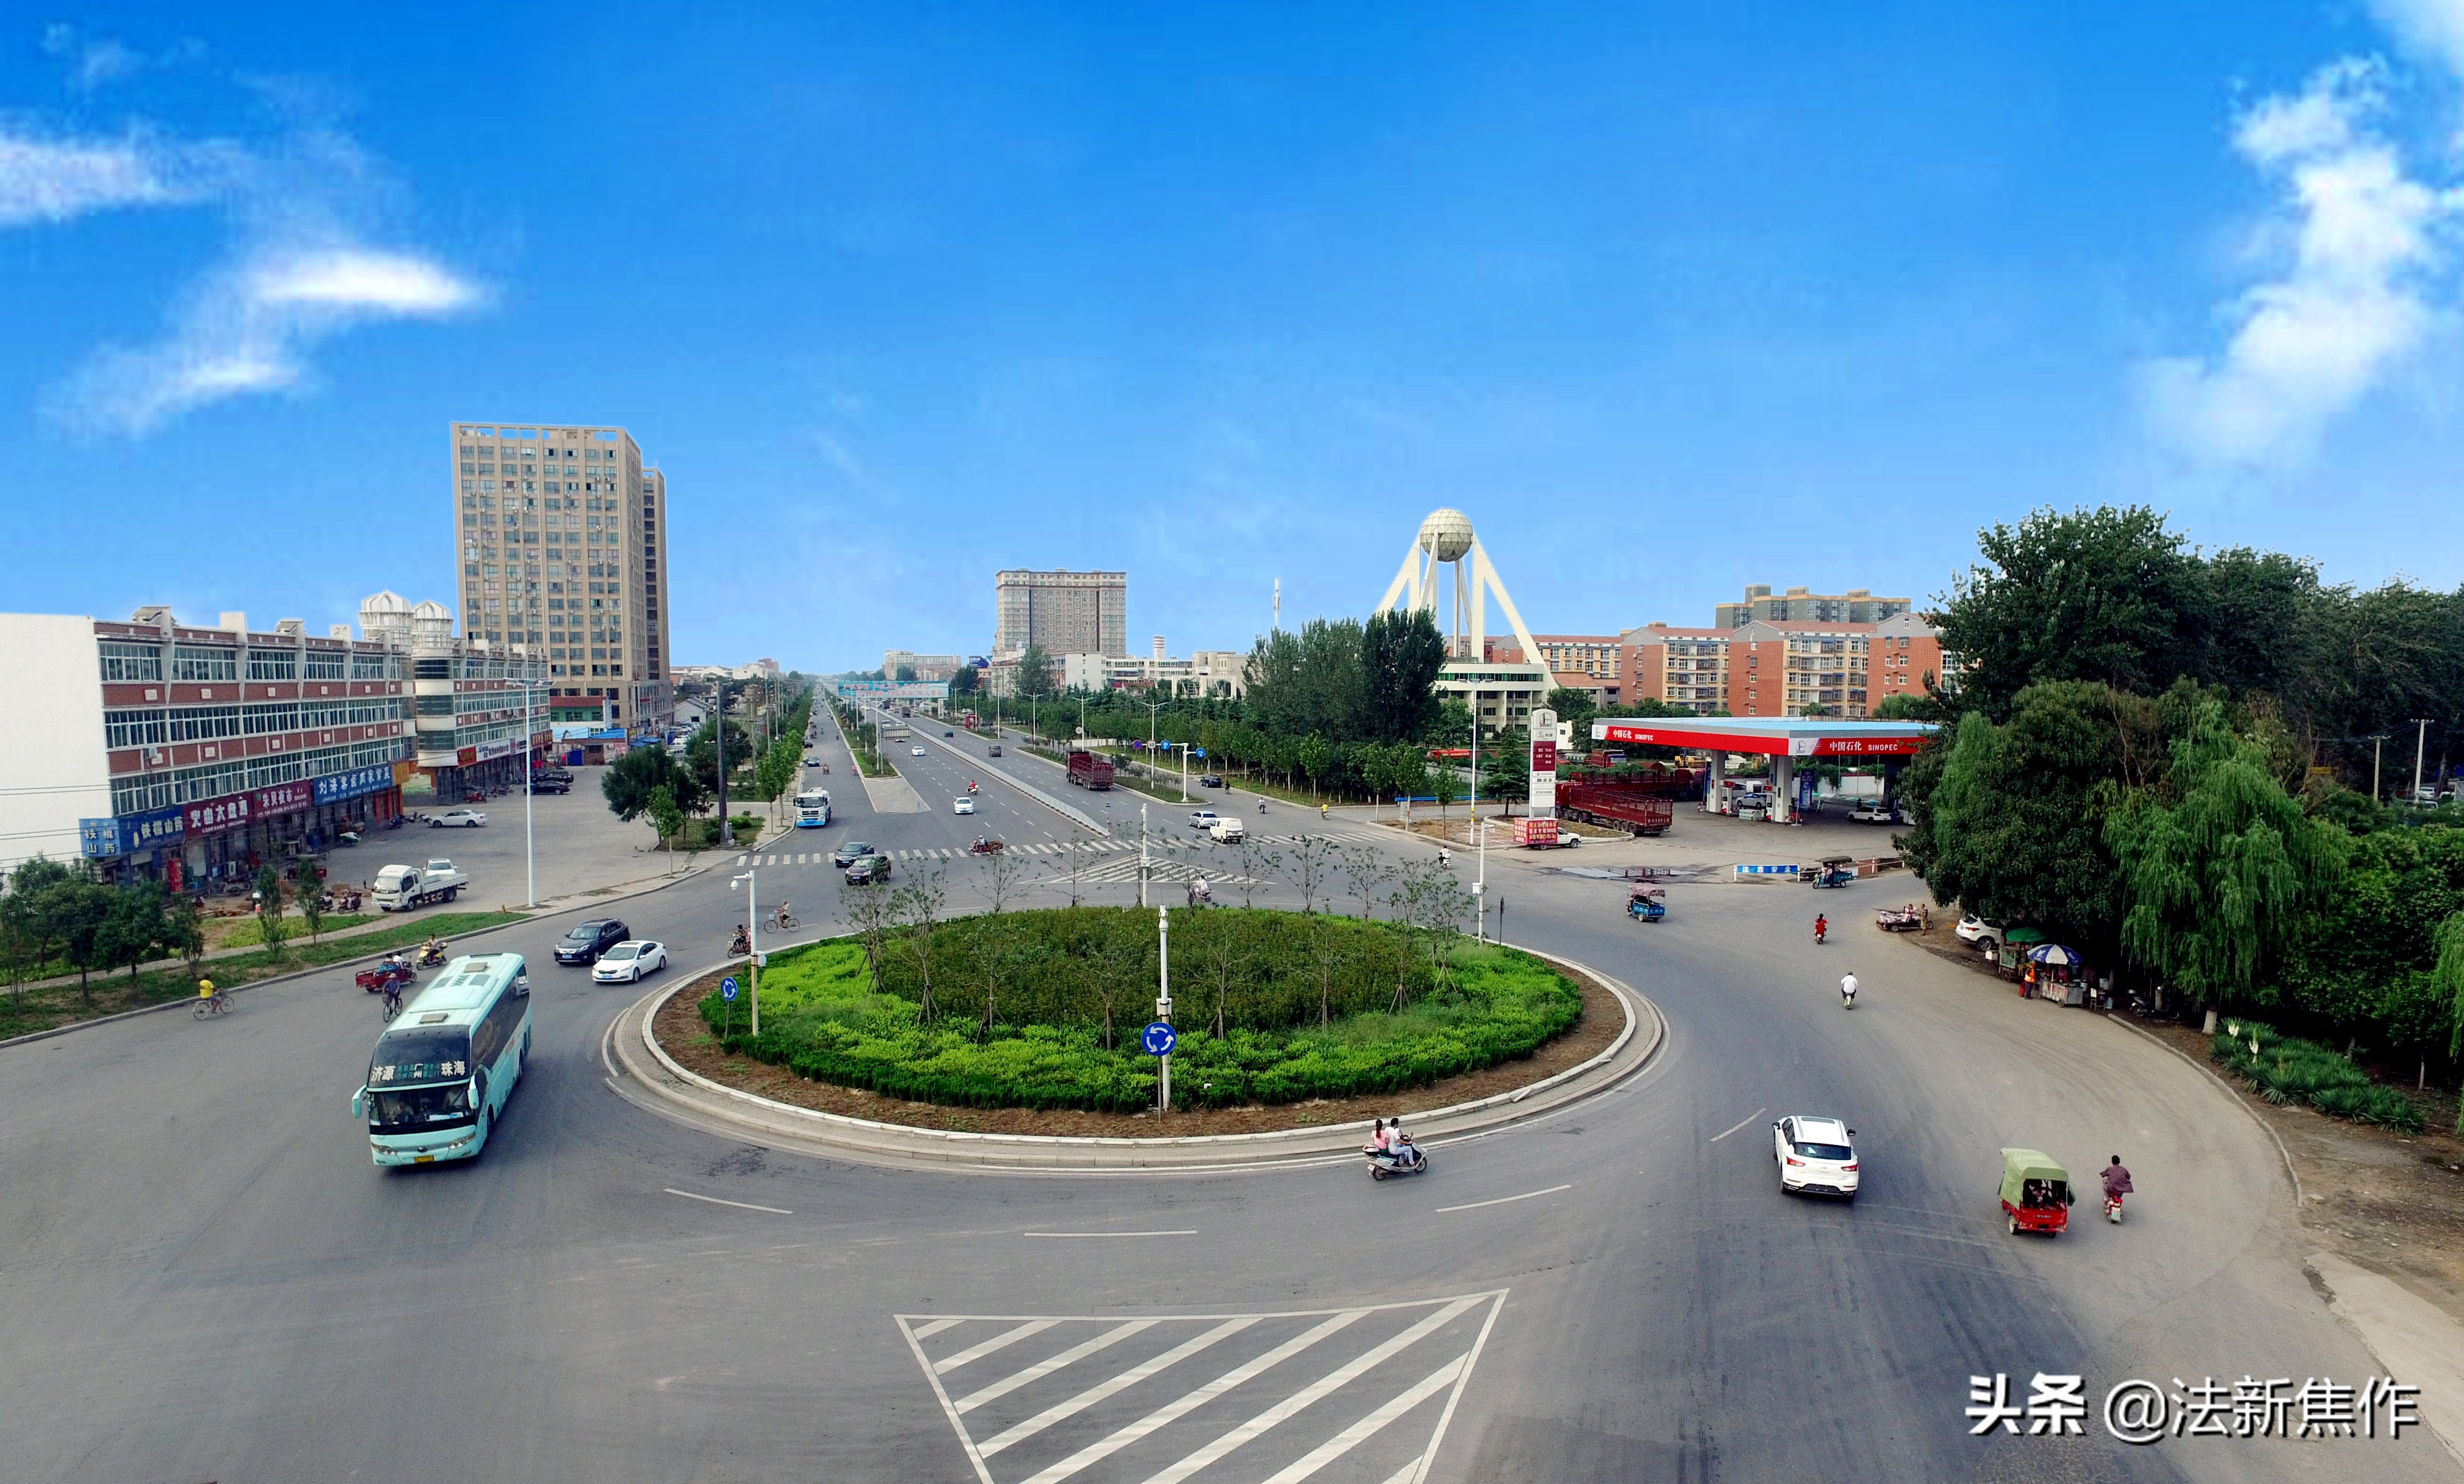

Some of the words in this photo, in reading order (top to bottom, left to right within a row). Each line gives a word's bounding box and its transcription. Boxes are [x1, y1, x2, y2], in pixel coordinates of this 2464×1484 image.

[1613, 729, 1632, 739] 中国石化
[1634, 733, 1654, 741] SINOPEC
[1829, 741, 1862, 752] 中国石化
[370, 1065, 396, 1082] 济源
[413, 1063, 424, 1078] 广州
[441, 1060, 465, 1077] 珠海
